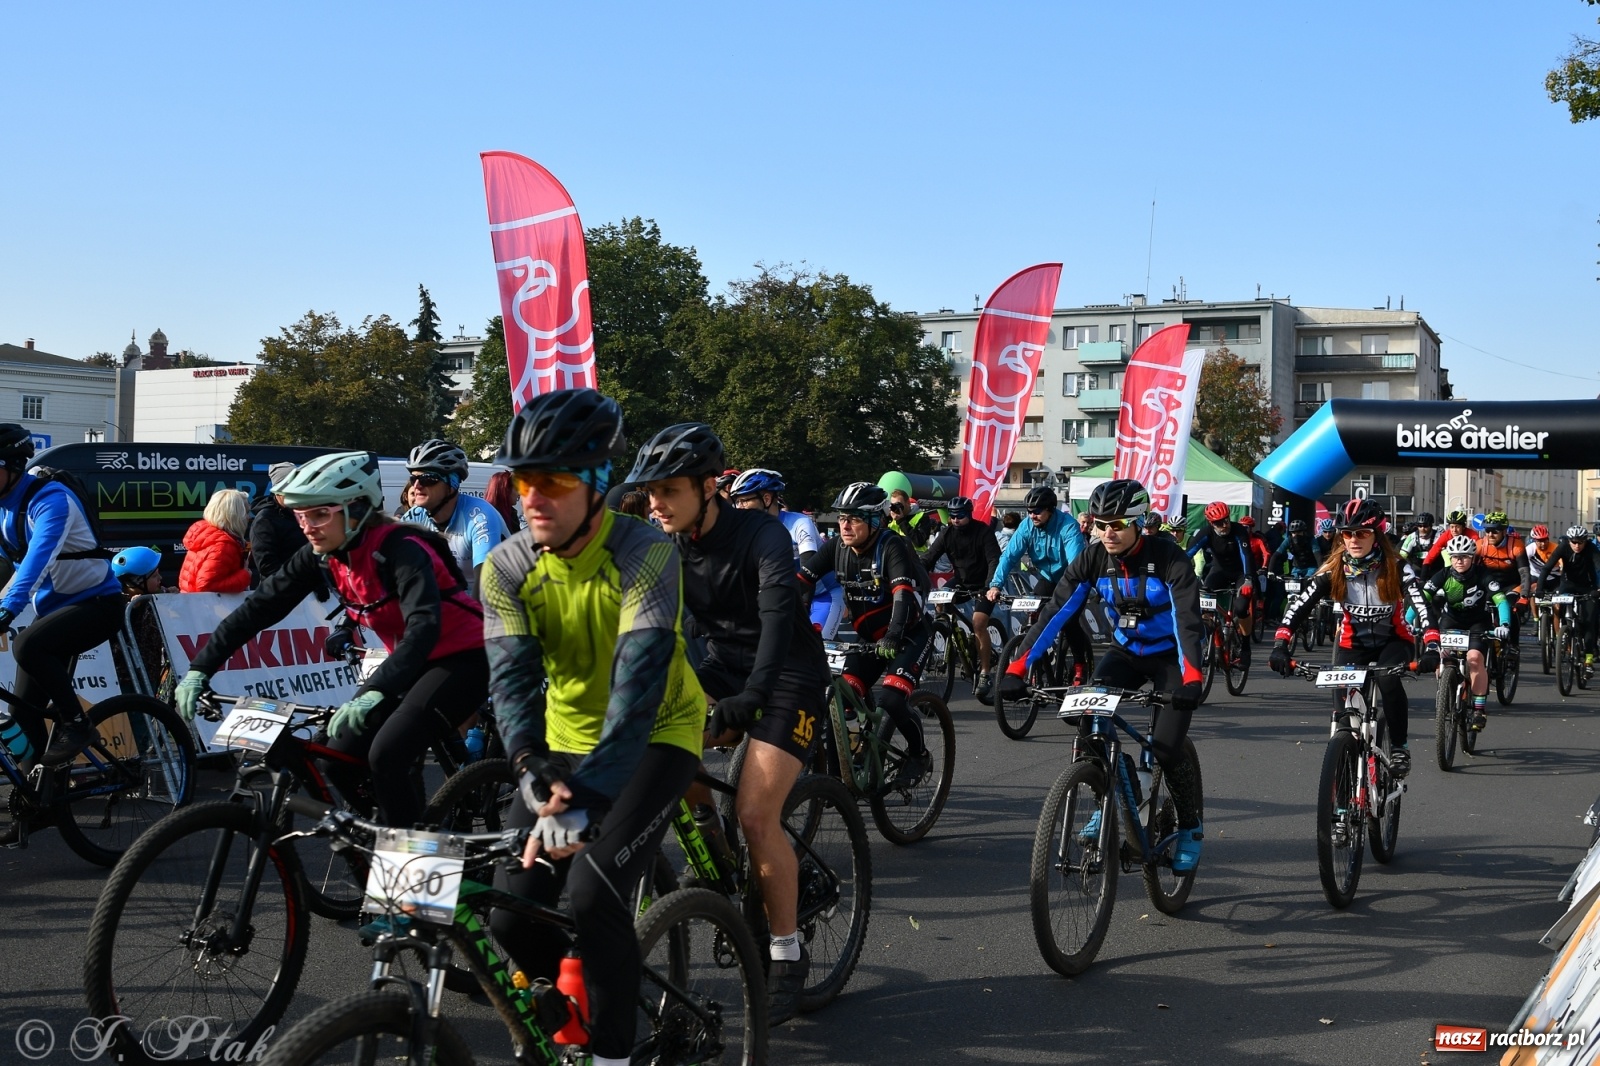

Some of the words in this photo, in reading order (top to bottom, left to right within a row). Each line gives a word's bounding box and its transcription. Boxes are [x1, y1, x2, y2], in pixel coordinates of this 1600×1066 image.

[193, 369, 213, 378] BLACK
[213, 369, 227, 377] RED
[228, 368, 249, 376] WHITE
[1396, 423, 1453, 449] bike
[1460, 424, 1549, 450] atelier
[137, 452, 180, 471] bike
[185, 453, 247, 471] atelier
[1346, 604, 1393, 615] STEVENS
[176, 626, 366, 672] YAKIM
[1442, 637, 1464, 645] 2143
[243, 678, 289, 699] TAKE
[288, 669, 335, 697] MORE
[1324, 673, 1357, 682] 3186
[1071, 696, 1109, 708] 1602
[793, 709, 816, 742] 16
[630, 812, 663, 852] FORCE
